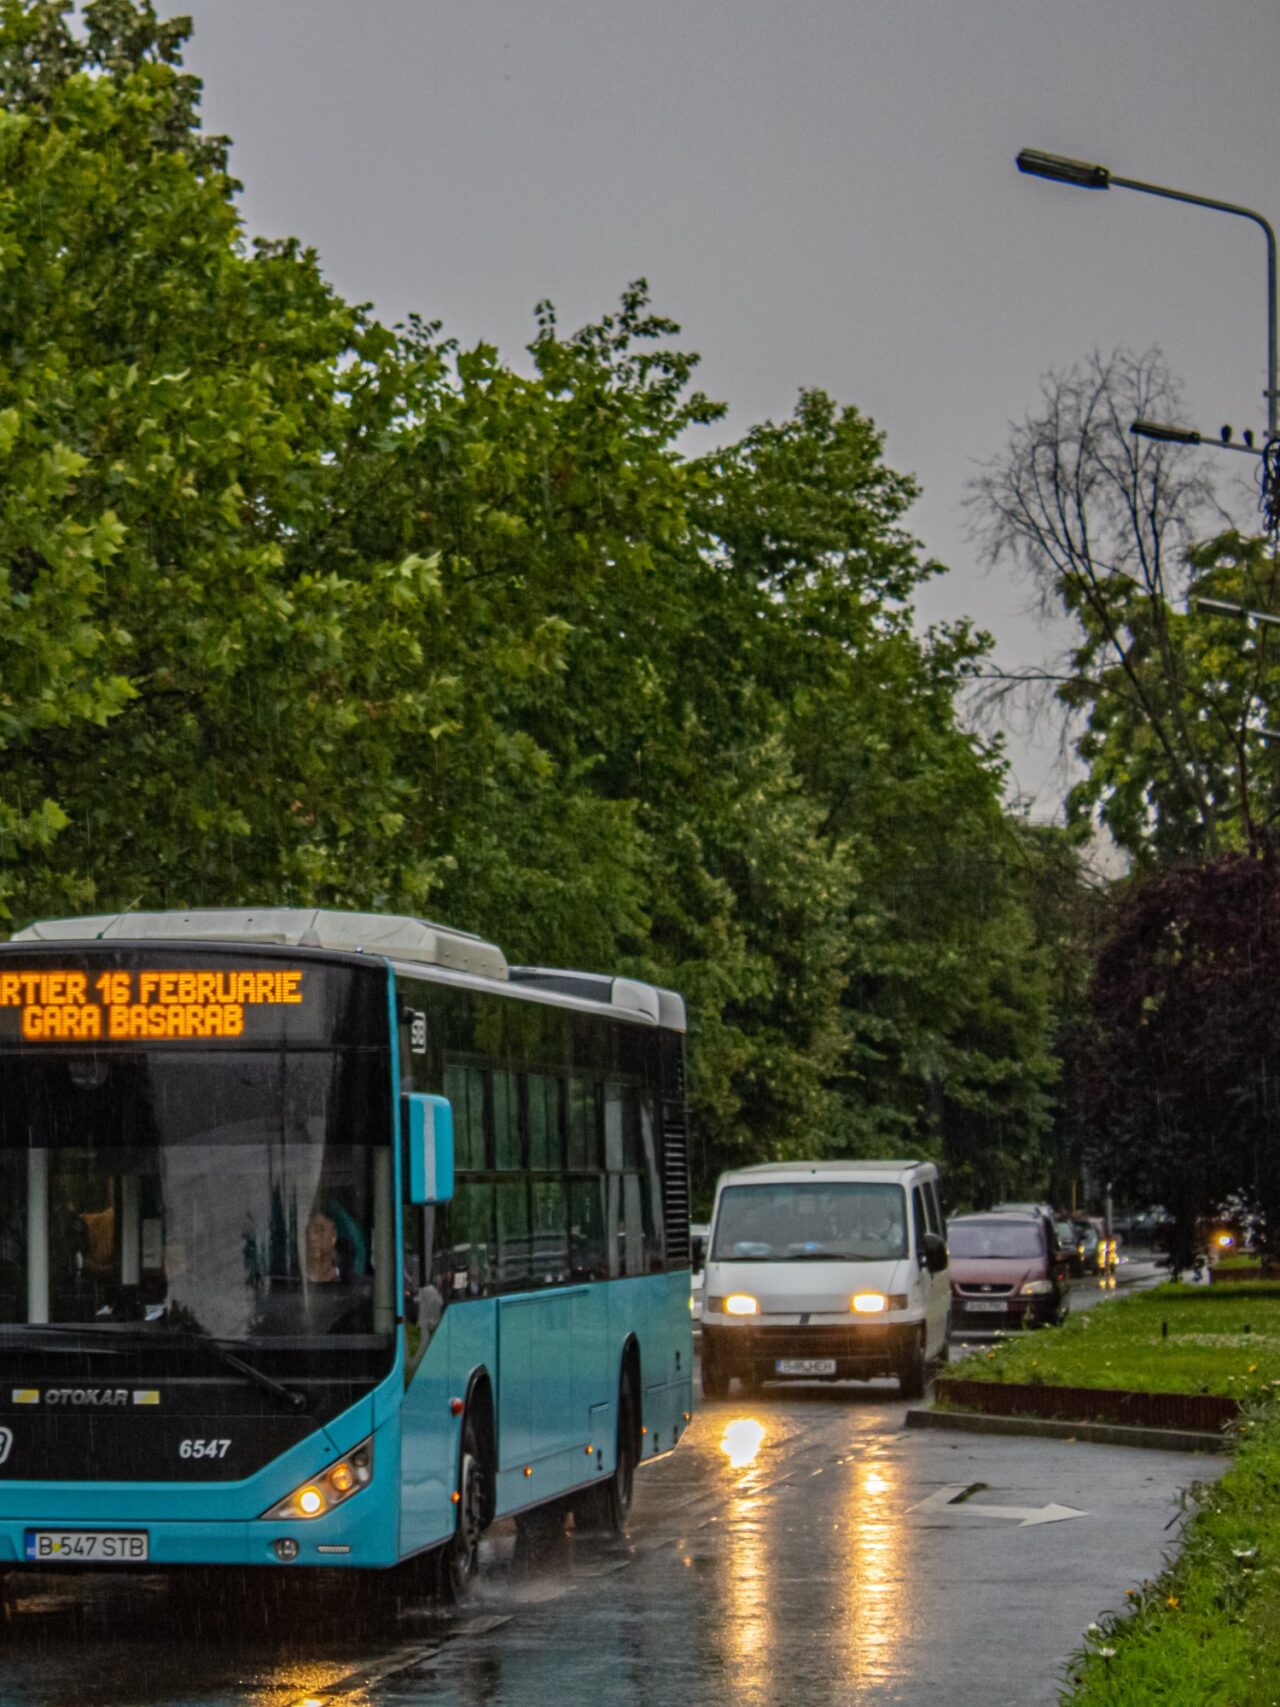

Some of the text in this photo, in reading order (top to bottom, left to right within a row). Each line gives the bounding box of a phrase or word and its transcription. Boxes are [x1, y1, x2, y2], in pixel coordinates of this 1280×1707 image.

[96, 972, 131, 1005] 16
[139, 971, 303, 1004] FEBRUARIE
[23, 1004, 244, 1038] GARA BASARAB
[44, 1389, 129, 1406] OTOKAR
[179, 1440, 231, 1458] 6547
[38, 1536, 144, 1557] B 547 STB
